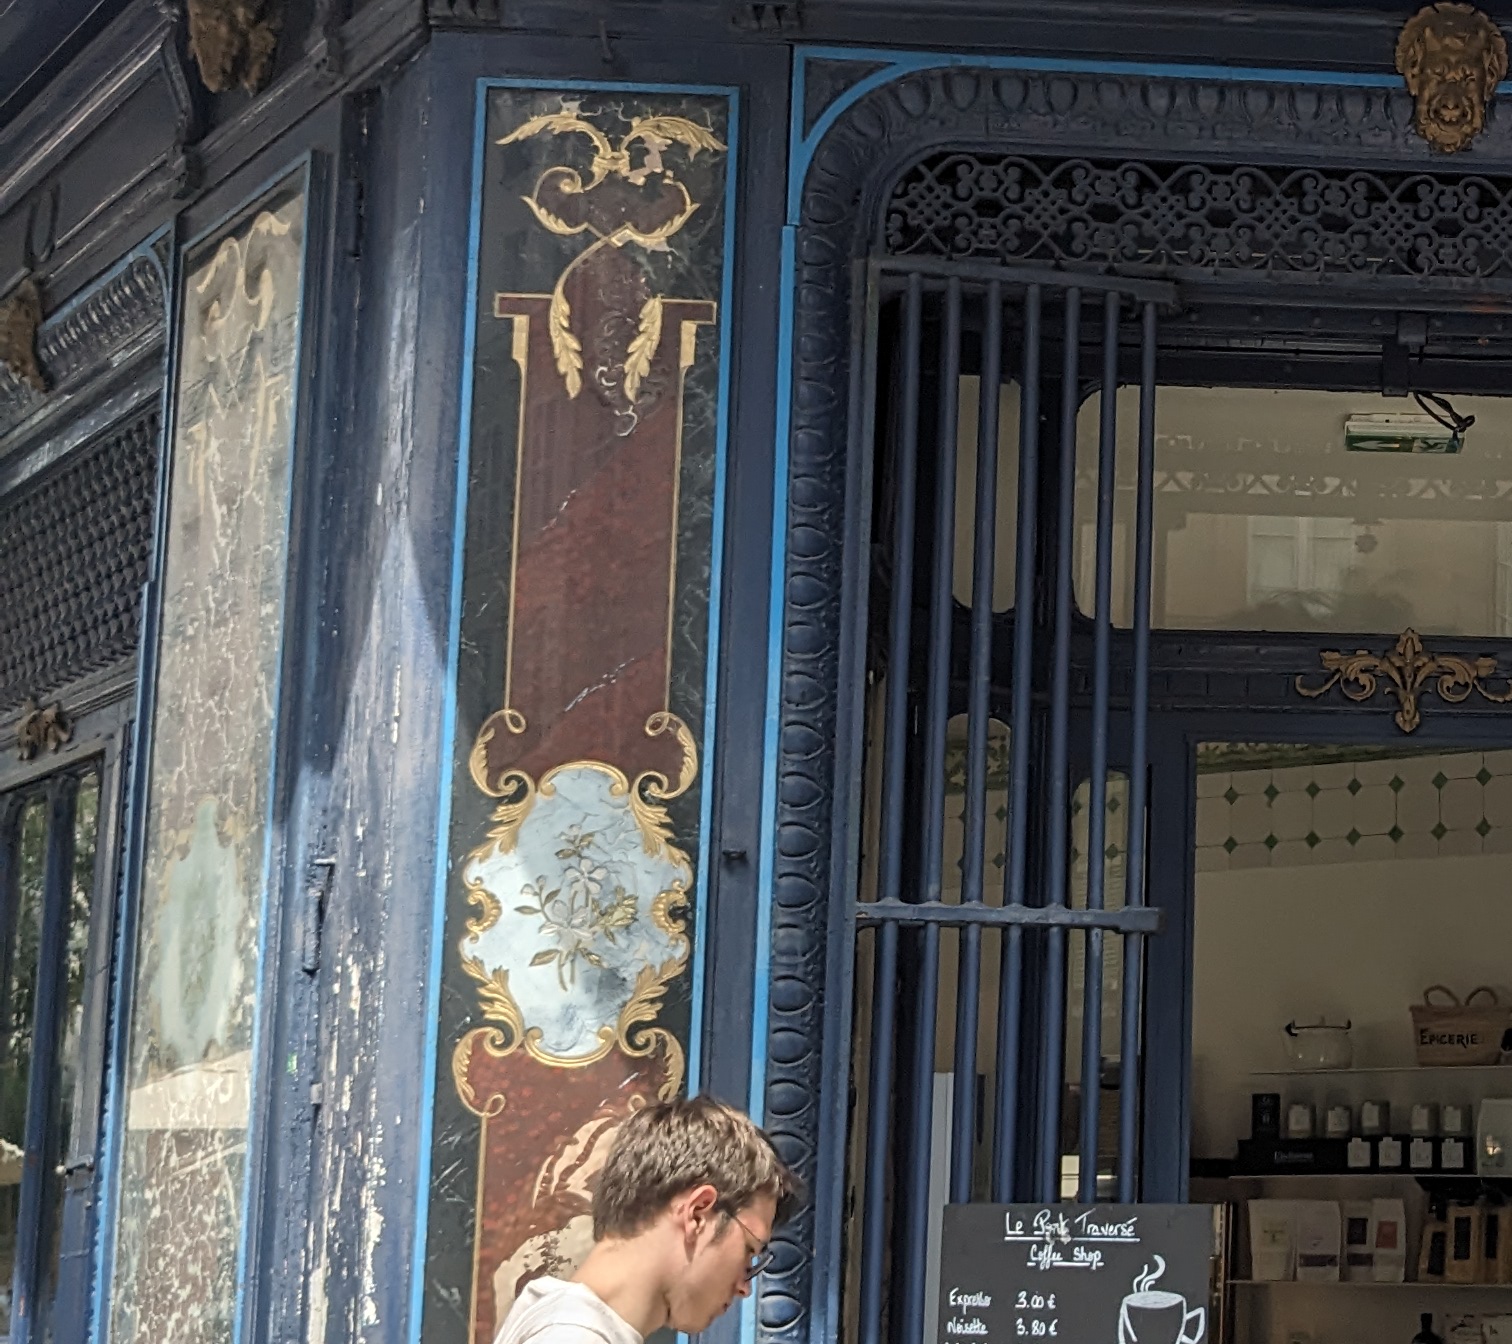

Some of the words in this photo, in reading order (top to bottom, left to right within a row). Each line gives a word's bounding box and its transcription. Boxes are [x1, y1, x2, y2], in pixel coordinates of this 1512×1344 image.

[1005, 1211, 1025, 1235] Le
[1033, 1208, 1071, 1236] Pont
[1074, 1207, 1138, 1237] Traversé
[1029, 1244, 1064, 1270] Coffee
[1073, 1244, 1102, 1271] Shop
[947, 1317, 988, 1334] Noisette
